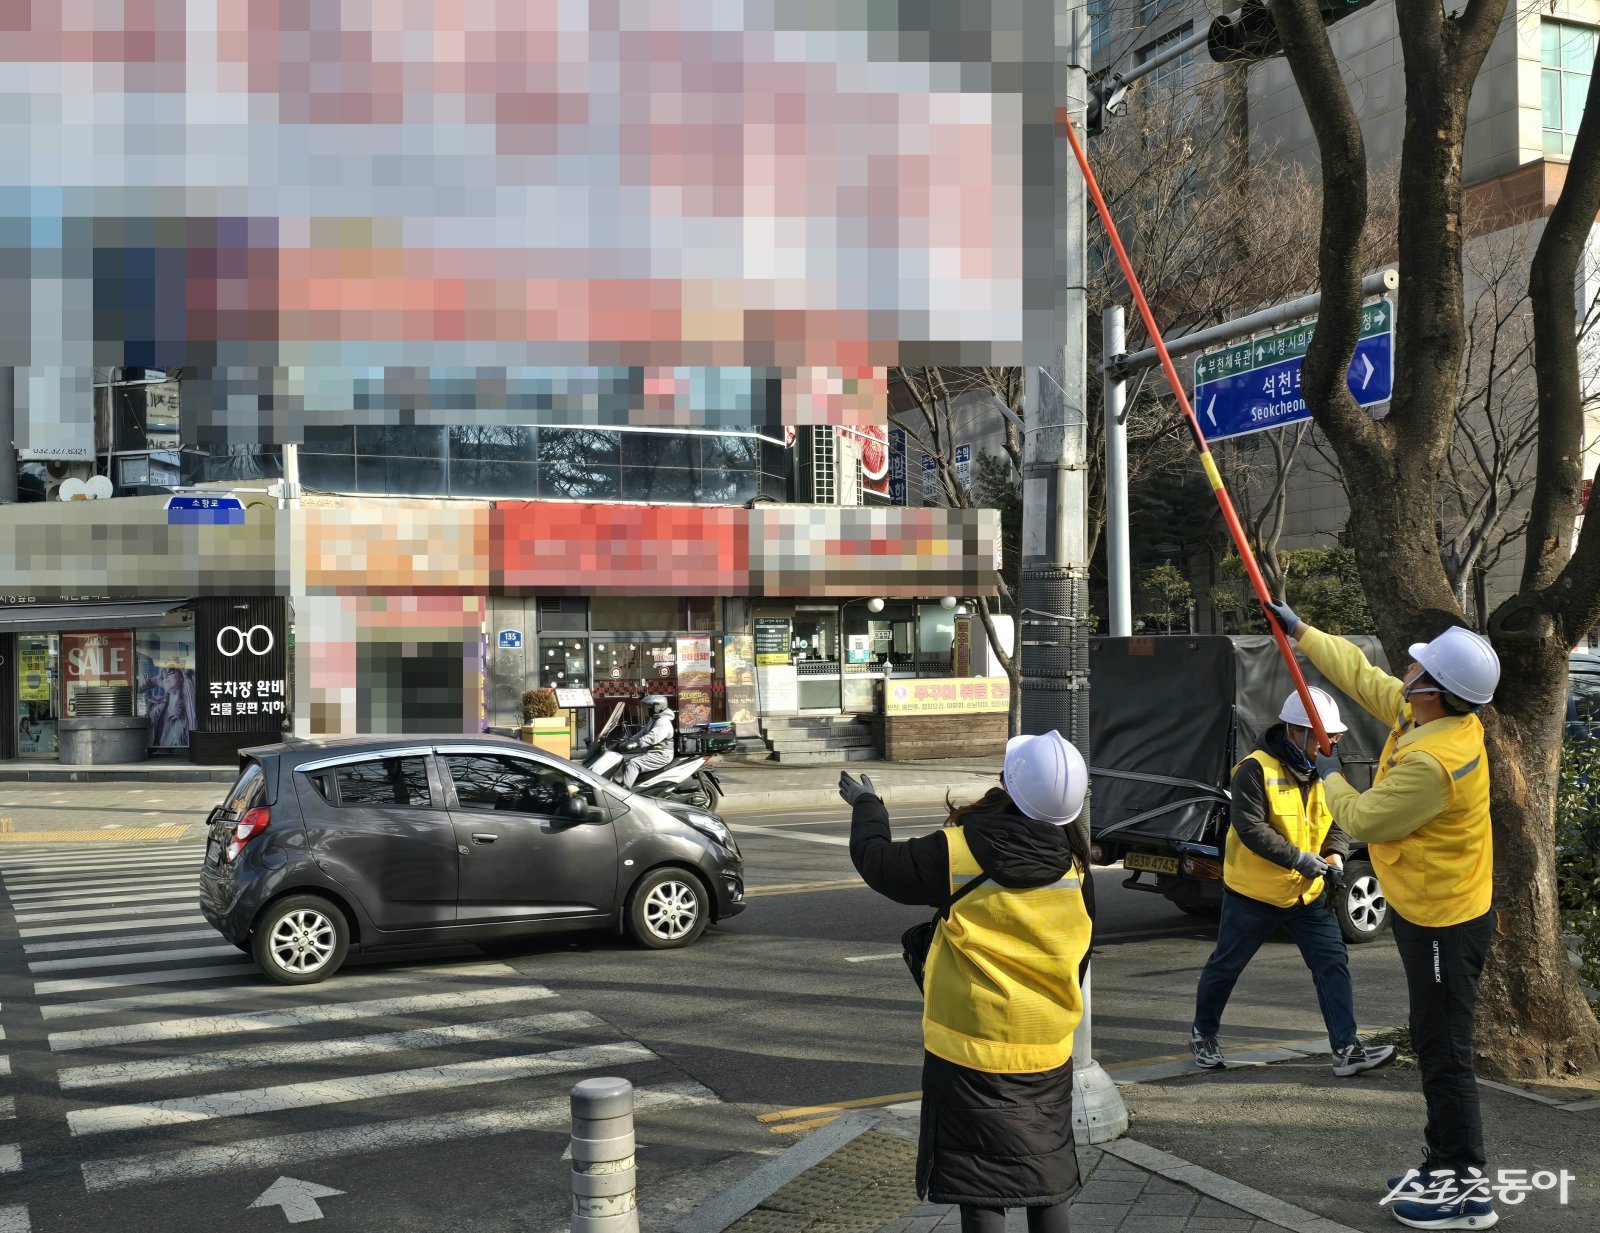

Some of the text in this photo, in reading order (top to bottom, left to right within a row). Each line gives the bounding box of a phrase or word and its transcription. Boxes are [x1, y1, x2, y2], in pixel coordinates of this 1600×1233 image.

[1361, 312, 1372, 331] 청
[1207, 349, 1252, 374] 부천체육관
[192, 499, 219, 508] 소향로
[84, 635, 109, 647] 2026
[504, 632, 517, 641] 135
[68, 647, 126, 676] SALE
[210, 680, 285, 698] 주차장 완비
[210, 702, 232, 716] 건물
[262, 701, 285, 714] 지하
